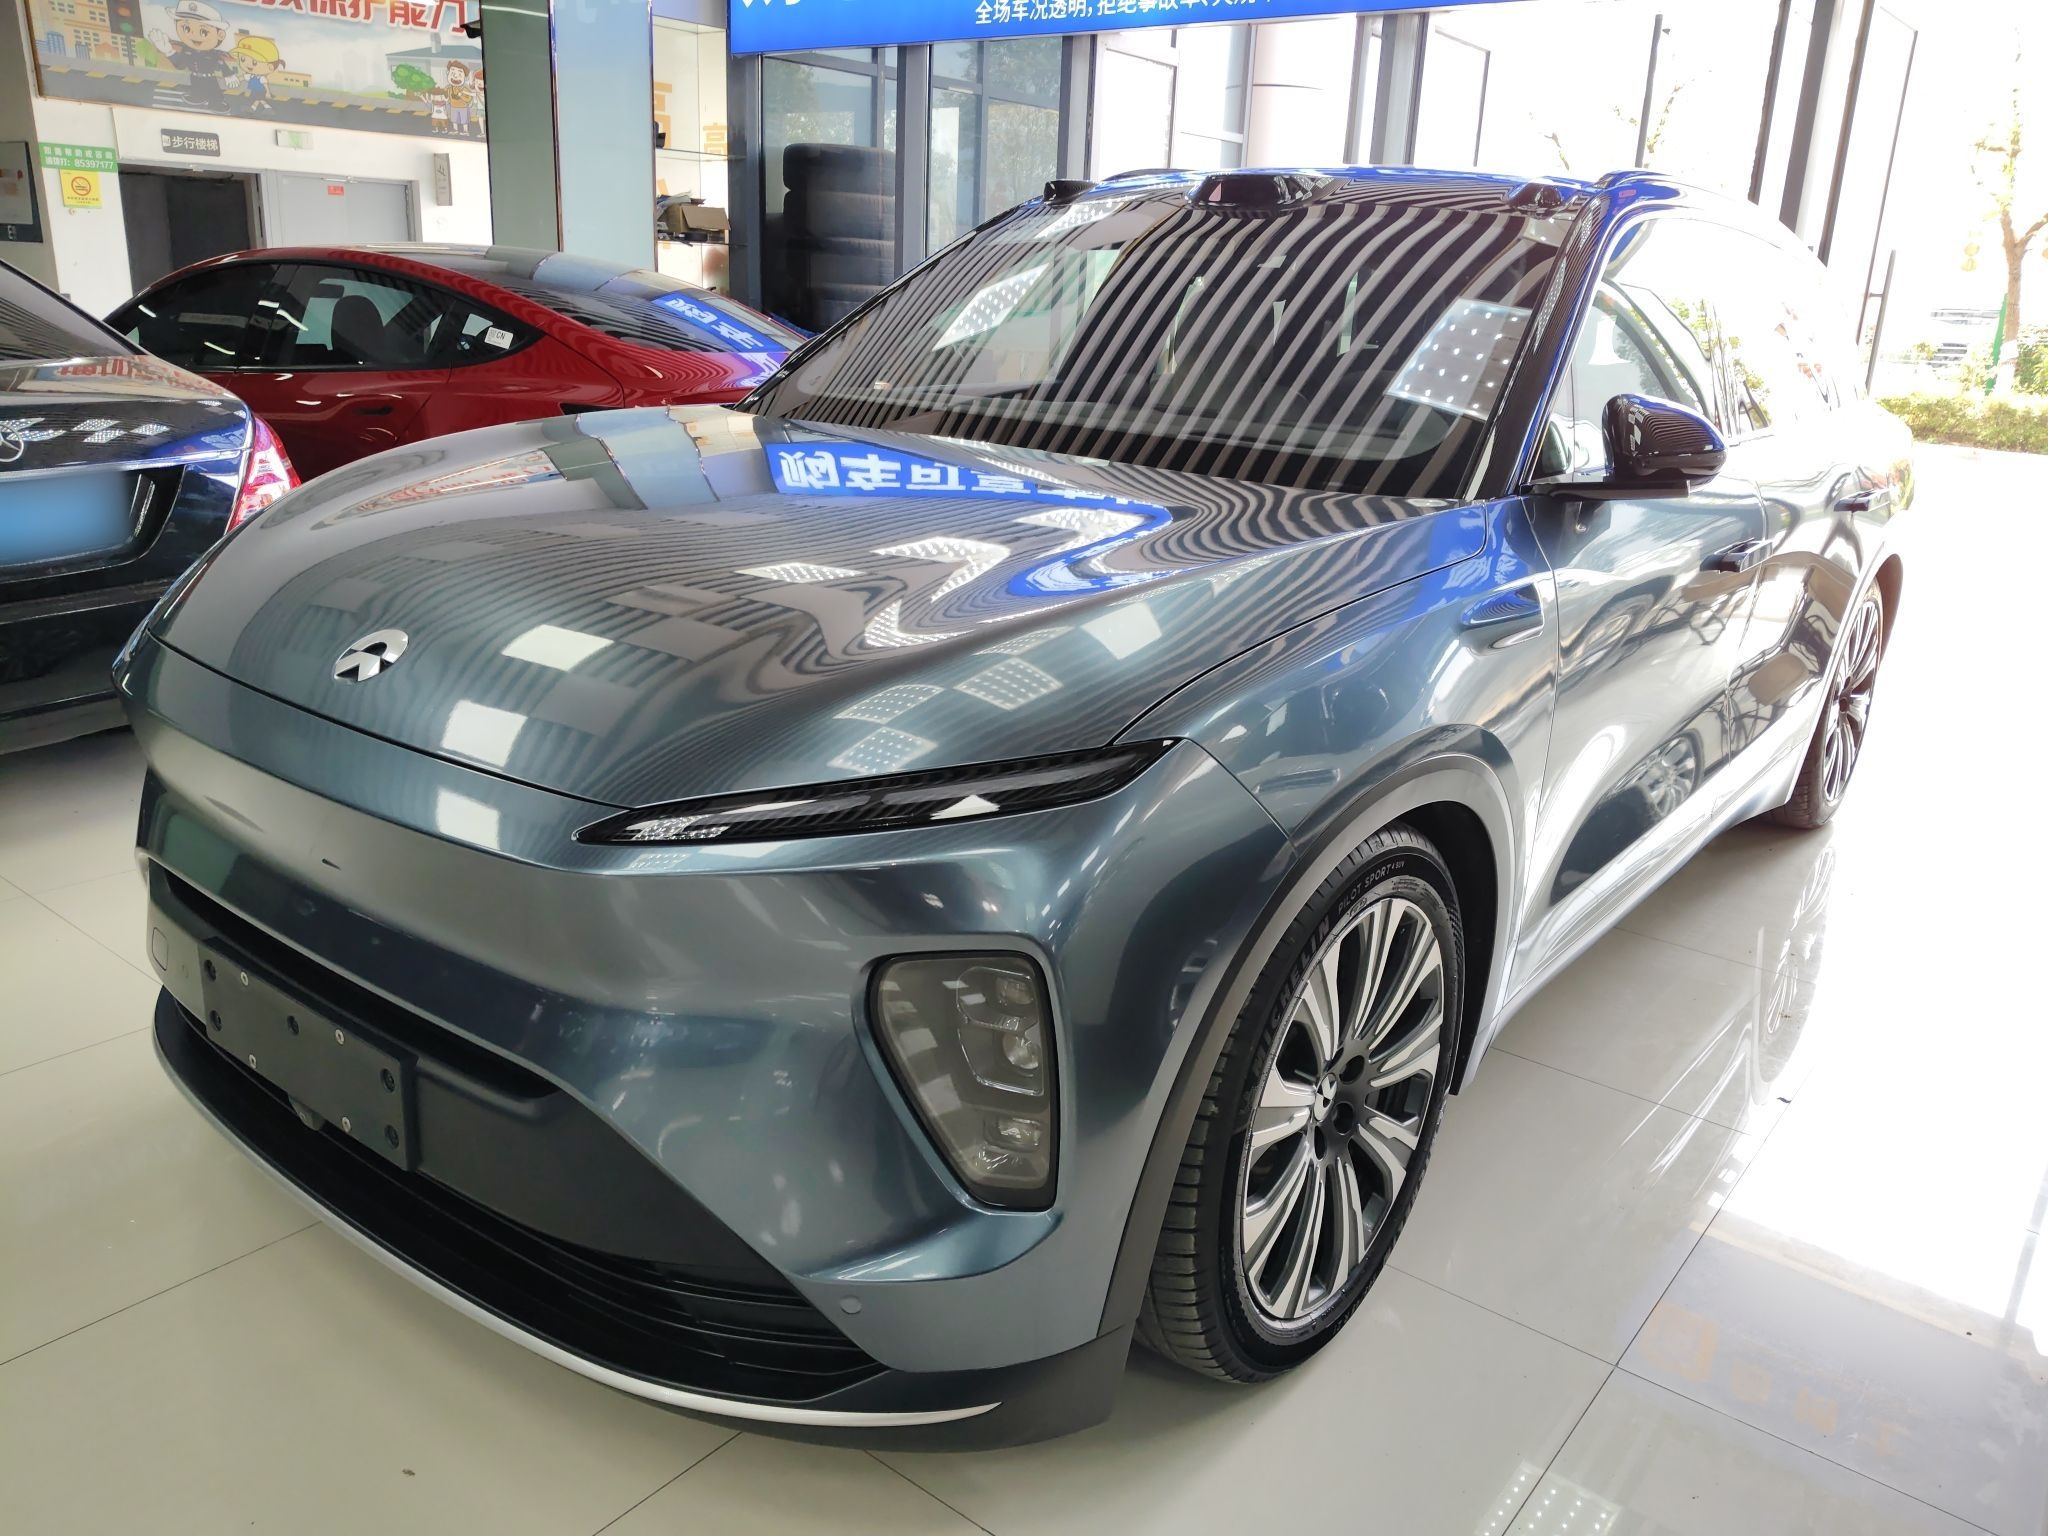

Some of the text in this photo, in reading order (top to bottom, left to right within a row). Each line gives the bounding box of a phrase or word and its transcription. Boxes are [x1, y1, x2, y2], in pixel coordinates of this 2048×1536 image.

[172, 135, 218, 151] 步行楼梯
[74, 159, 114, 169] 85397177
[496, 331, 506, 340] CN
[1338, 883, 1362, 915] PILOT
[1364, 863, 1392, 888] SPORT
[1252, 914, 1331, 1077] MICHELIN
